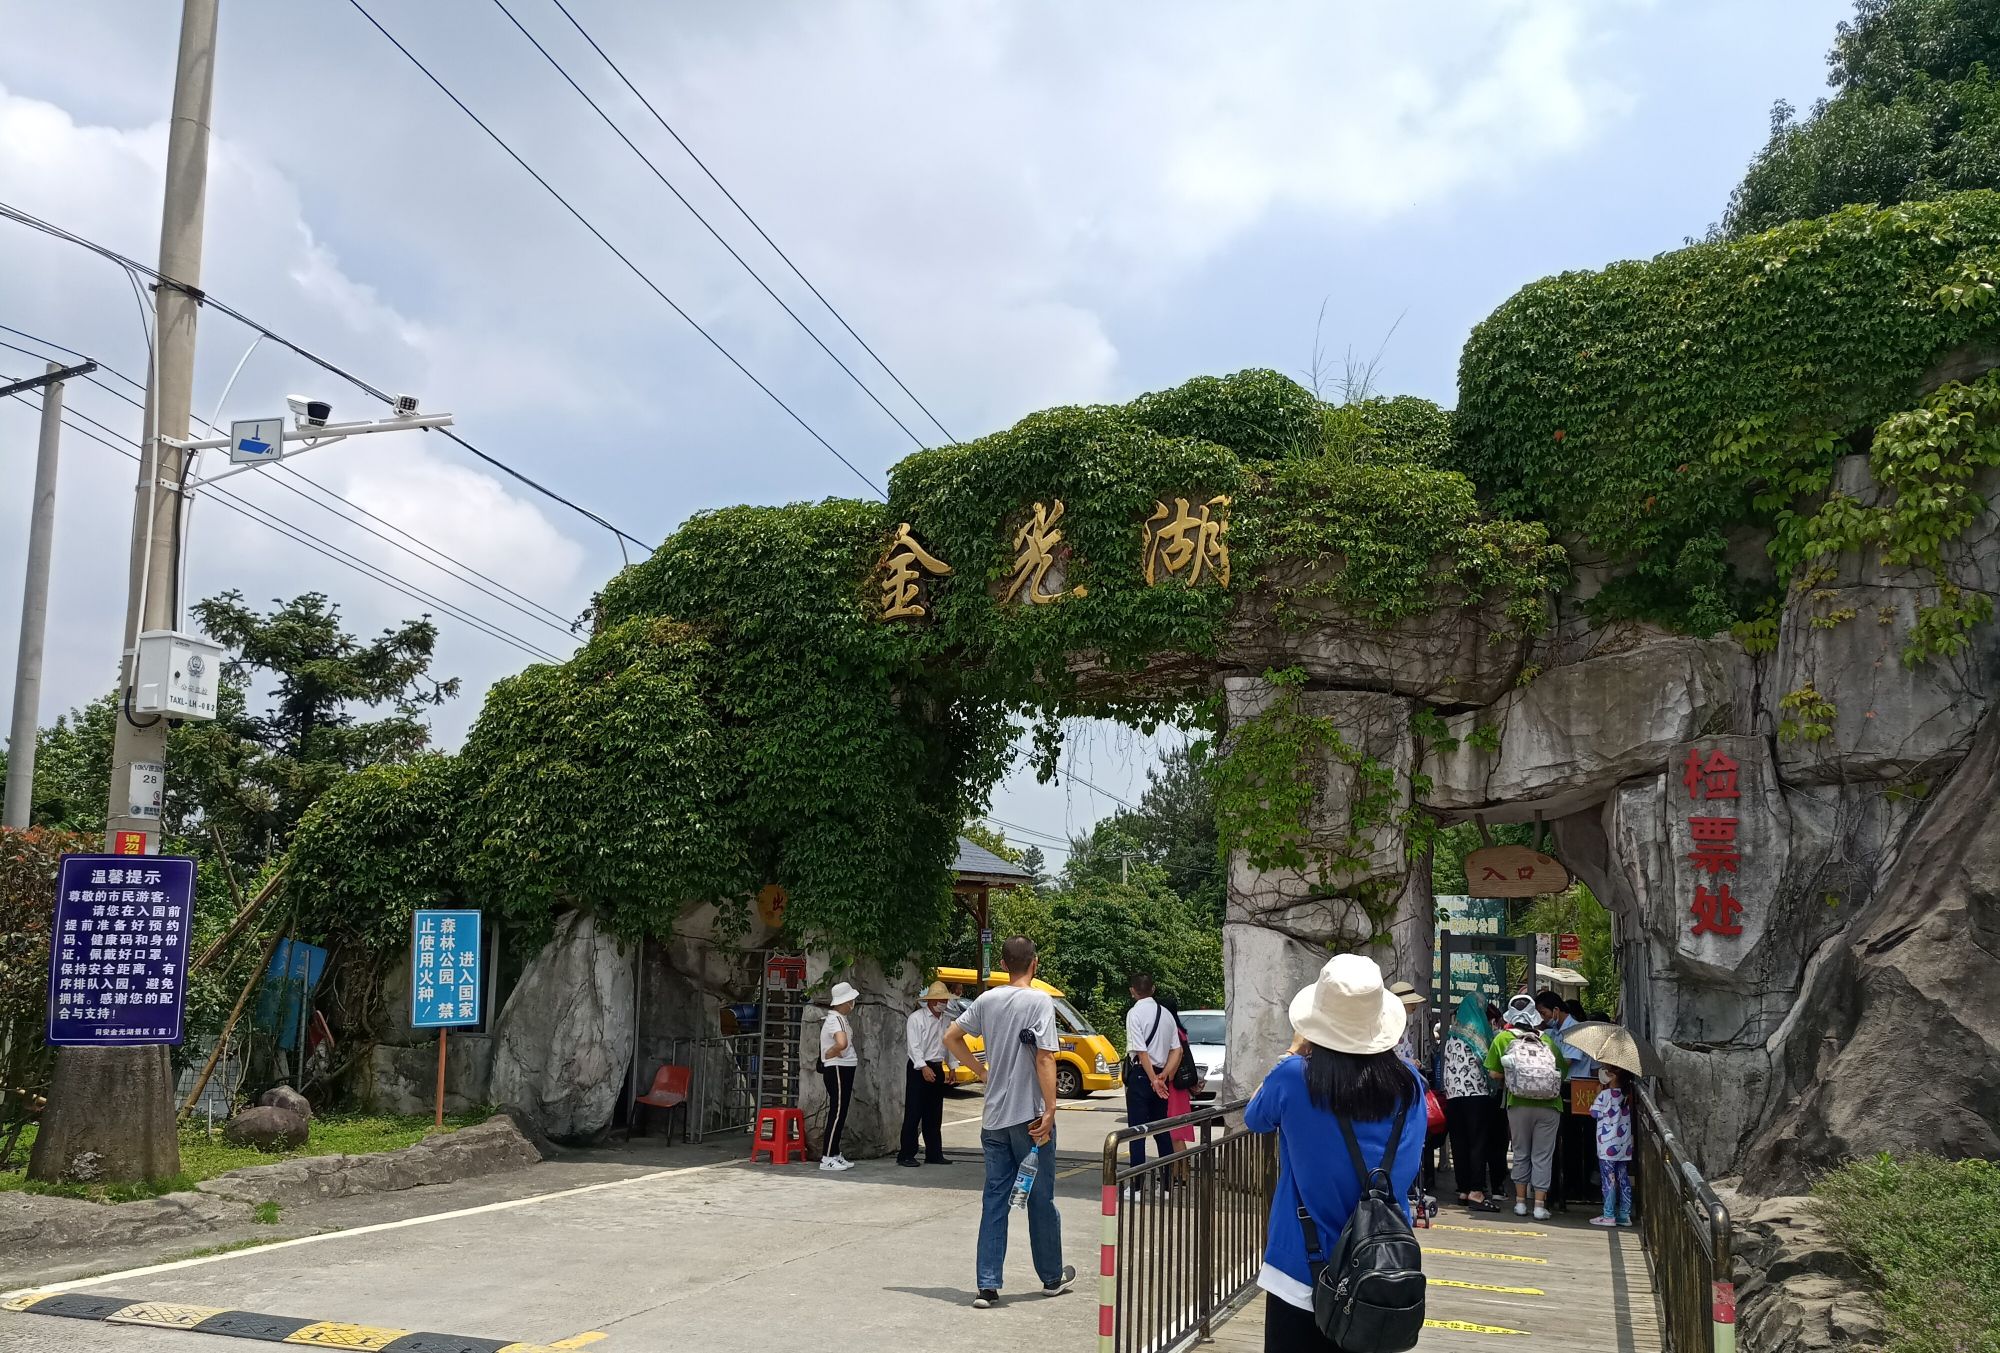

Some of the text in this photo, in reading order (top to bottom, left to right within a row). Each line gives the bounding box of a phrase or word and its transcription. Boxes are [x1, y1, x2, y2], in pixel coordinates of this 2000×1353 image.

[877, 495, 1232, 621] 金光湖
[143, 774, 157, 784] 28
[1683, 749, 1743, 936] 检票处
[91, 869, 162, 884] 温馨提示
[1482, 866, 1535, 880] 入口
[68, 890, 170, 903] 尊敬的市民游客：
[92, 905, 182, 918] 请您在入园前
[64, 919, 180, 932] 提前准备好预约
[63, 934, 179, 946] 码、健康码和身份
[62, 948, 170, 961] 证，佩戴好口罩，
[60, 963, 176, 976] 保持安全距离，有
[438, 918, 456, 1019] 森林公园，禁
[59, 977, 175, 990] 序排队入园，避免
[459, 951, 475, 1018] 进入国家
[58, 992, 174, 1005] 拥堵。感谢您的配
